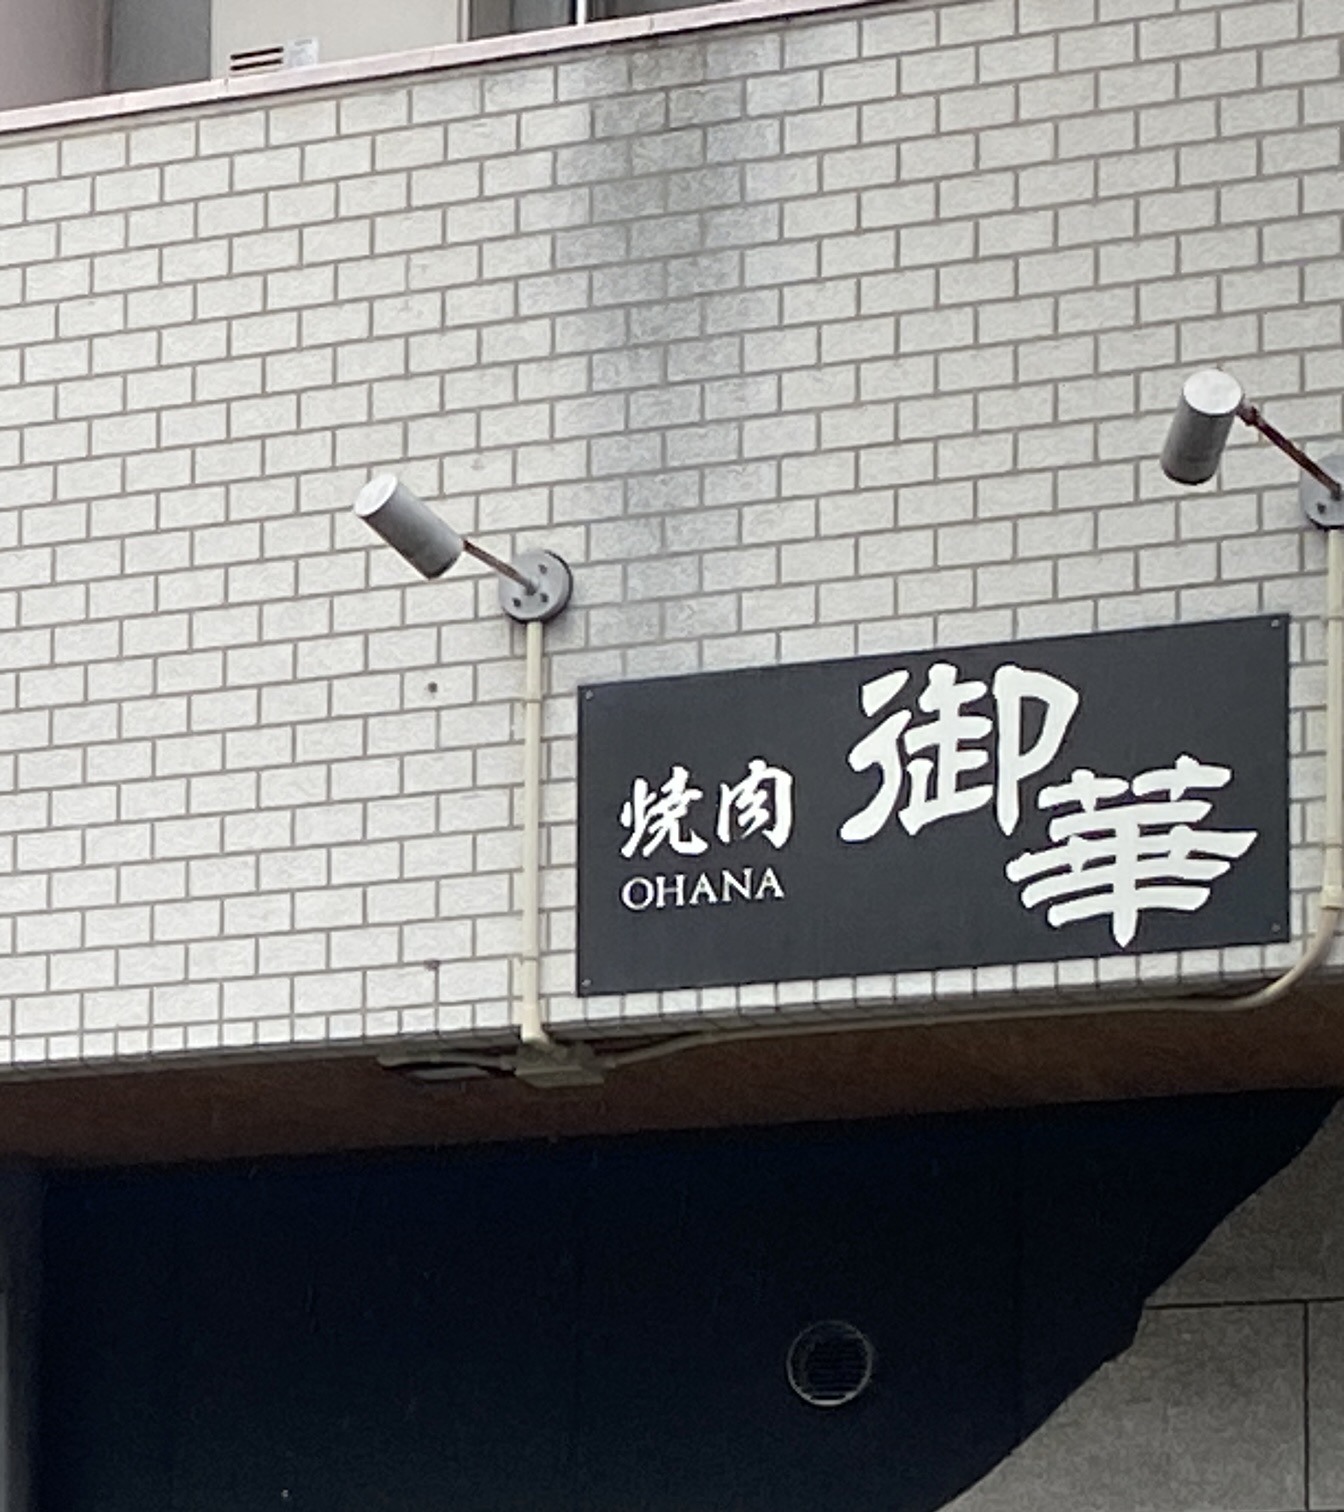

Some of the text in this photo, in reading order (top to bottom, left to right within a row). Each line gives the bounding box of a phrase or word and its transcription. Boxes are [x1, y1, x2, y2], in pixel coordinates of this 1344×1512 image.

[620, 758, 793, 859] 焼肉
[840, 661, 1259, 948] 御華
[621, 867, 785, 911] OHANA
